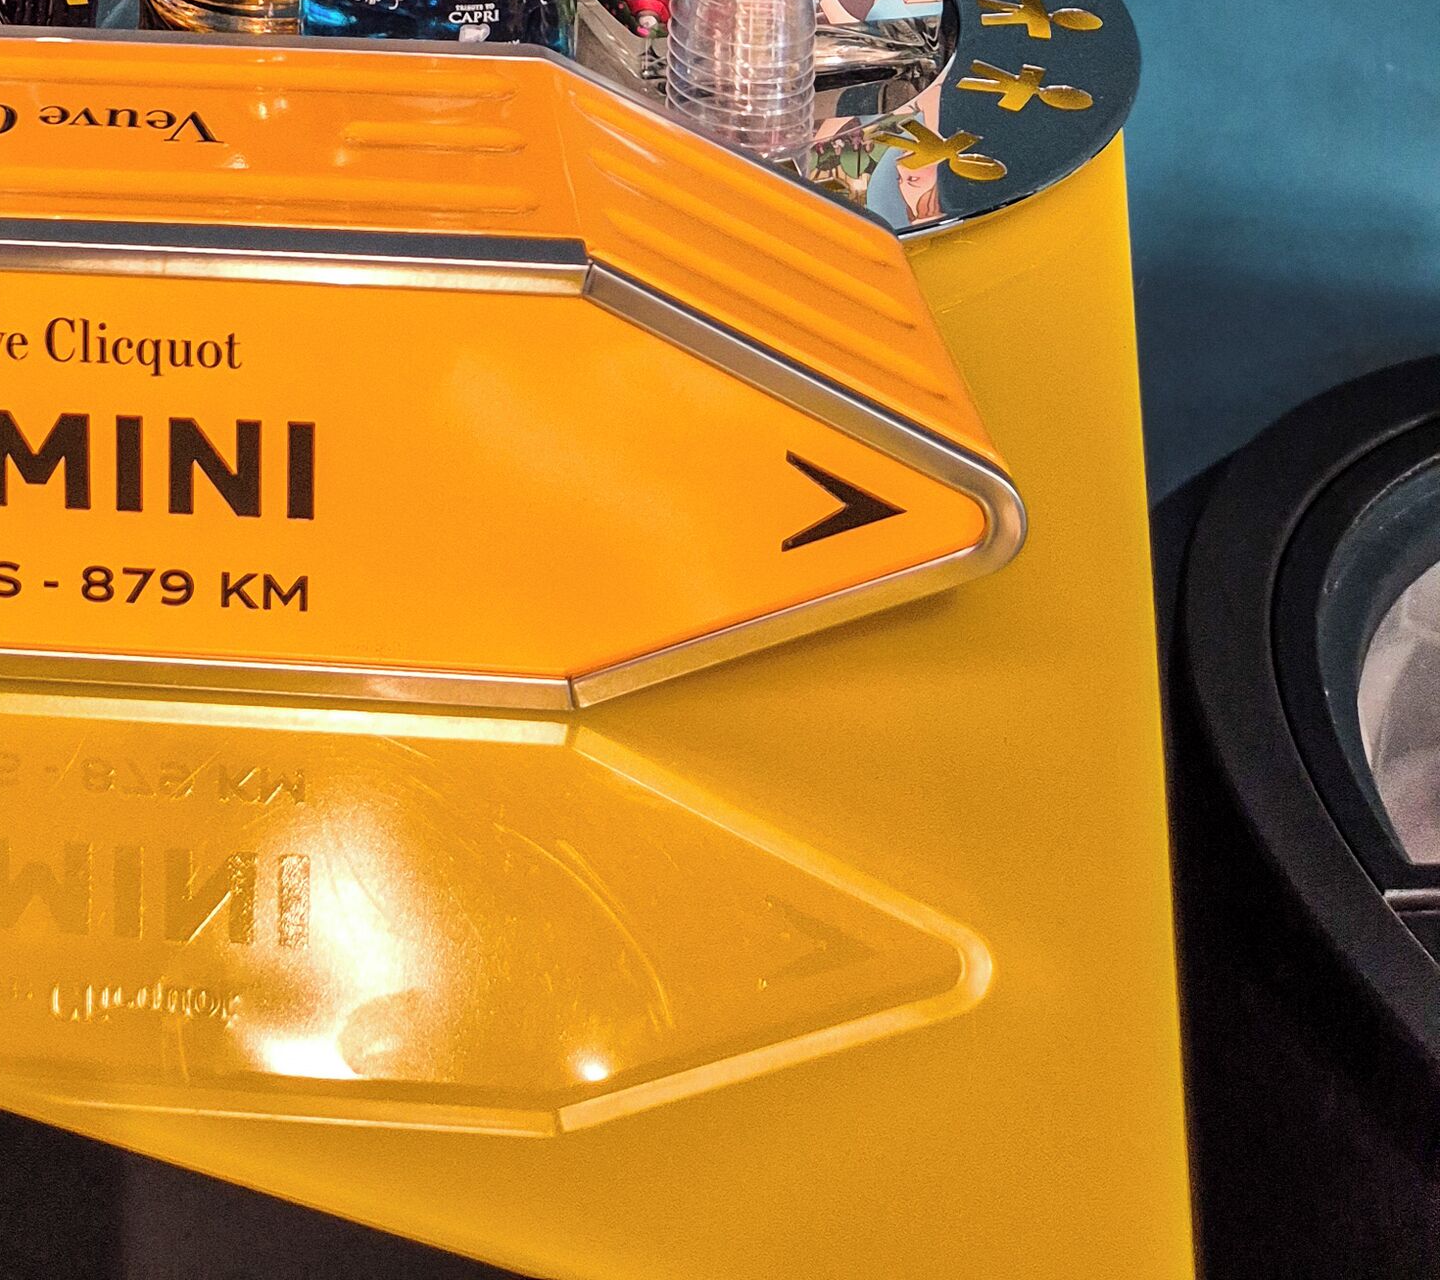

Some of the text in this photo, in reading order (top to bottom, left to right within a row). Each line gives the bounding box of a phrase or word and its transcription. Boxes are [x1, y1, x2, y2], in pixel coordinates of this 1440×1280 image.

[448, 9, 499, 24] CAPRI
[39, 103, 224, 144] Veuve
[44, 316, 243, 377] Clicquot
[80, 565, 195, 607] 879
[220, 570, 310, 613] KM
